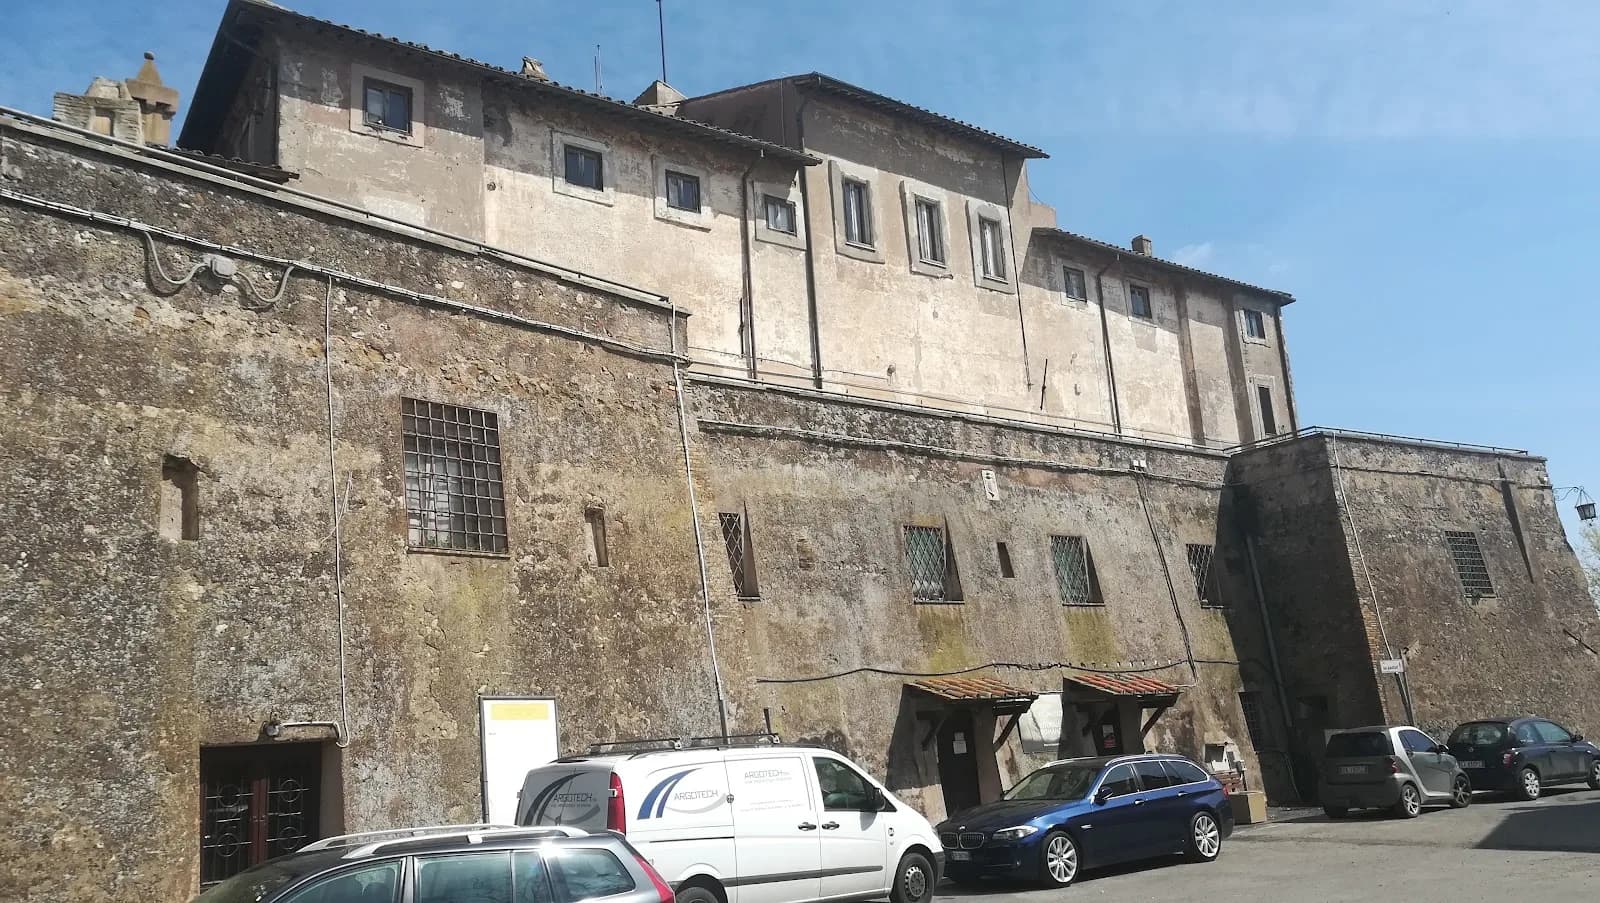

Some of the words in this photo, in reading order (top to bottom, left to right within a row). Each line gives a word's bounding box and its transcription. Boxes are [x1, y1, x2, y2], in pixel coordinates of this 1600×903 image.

[744, 769, 784, 779] ARGOTECH
[553, 792, 593, 803] ARGOTECH
[674, 788, 719, 801] ARGOTECH
